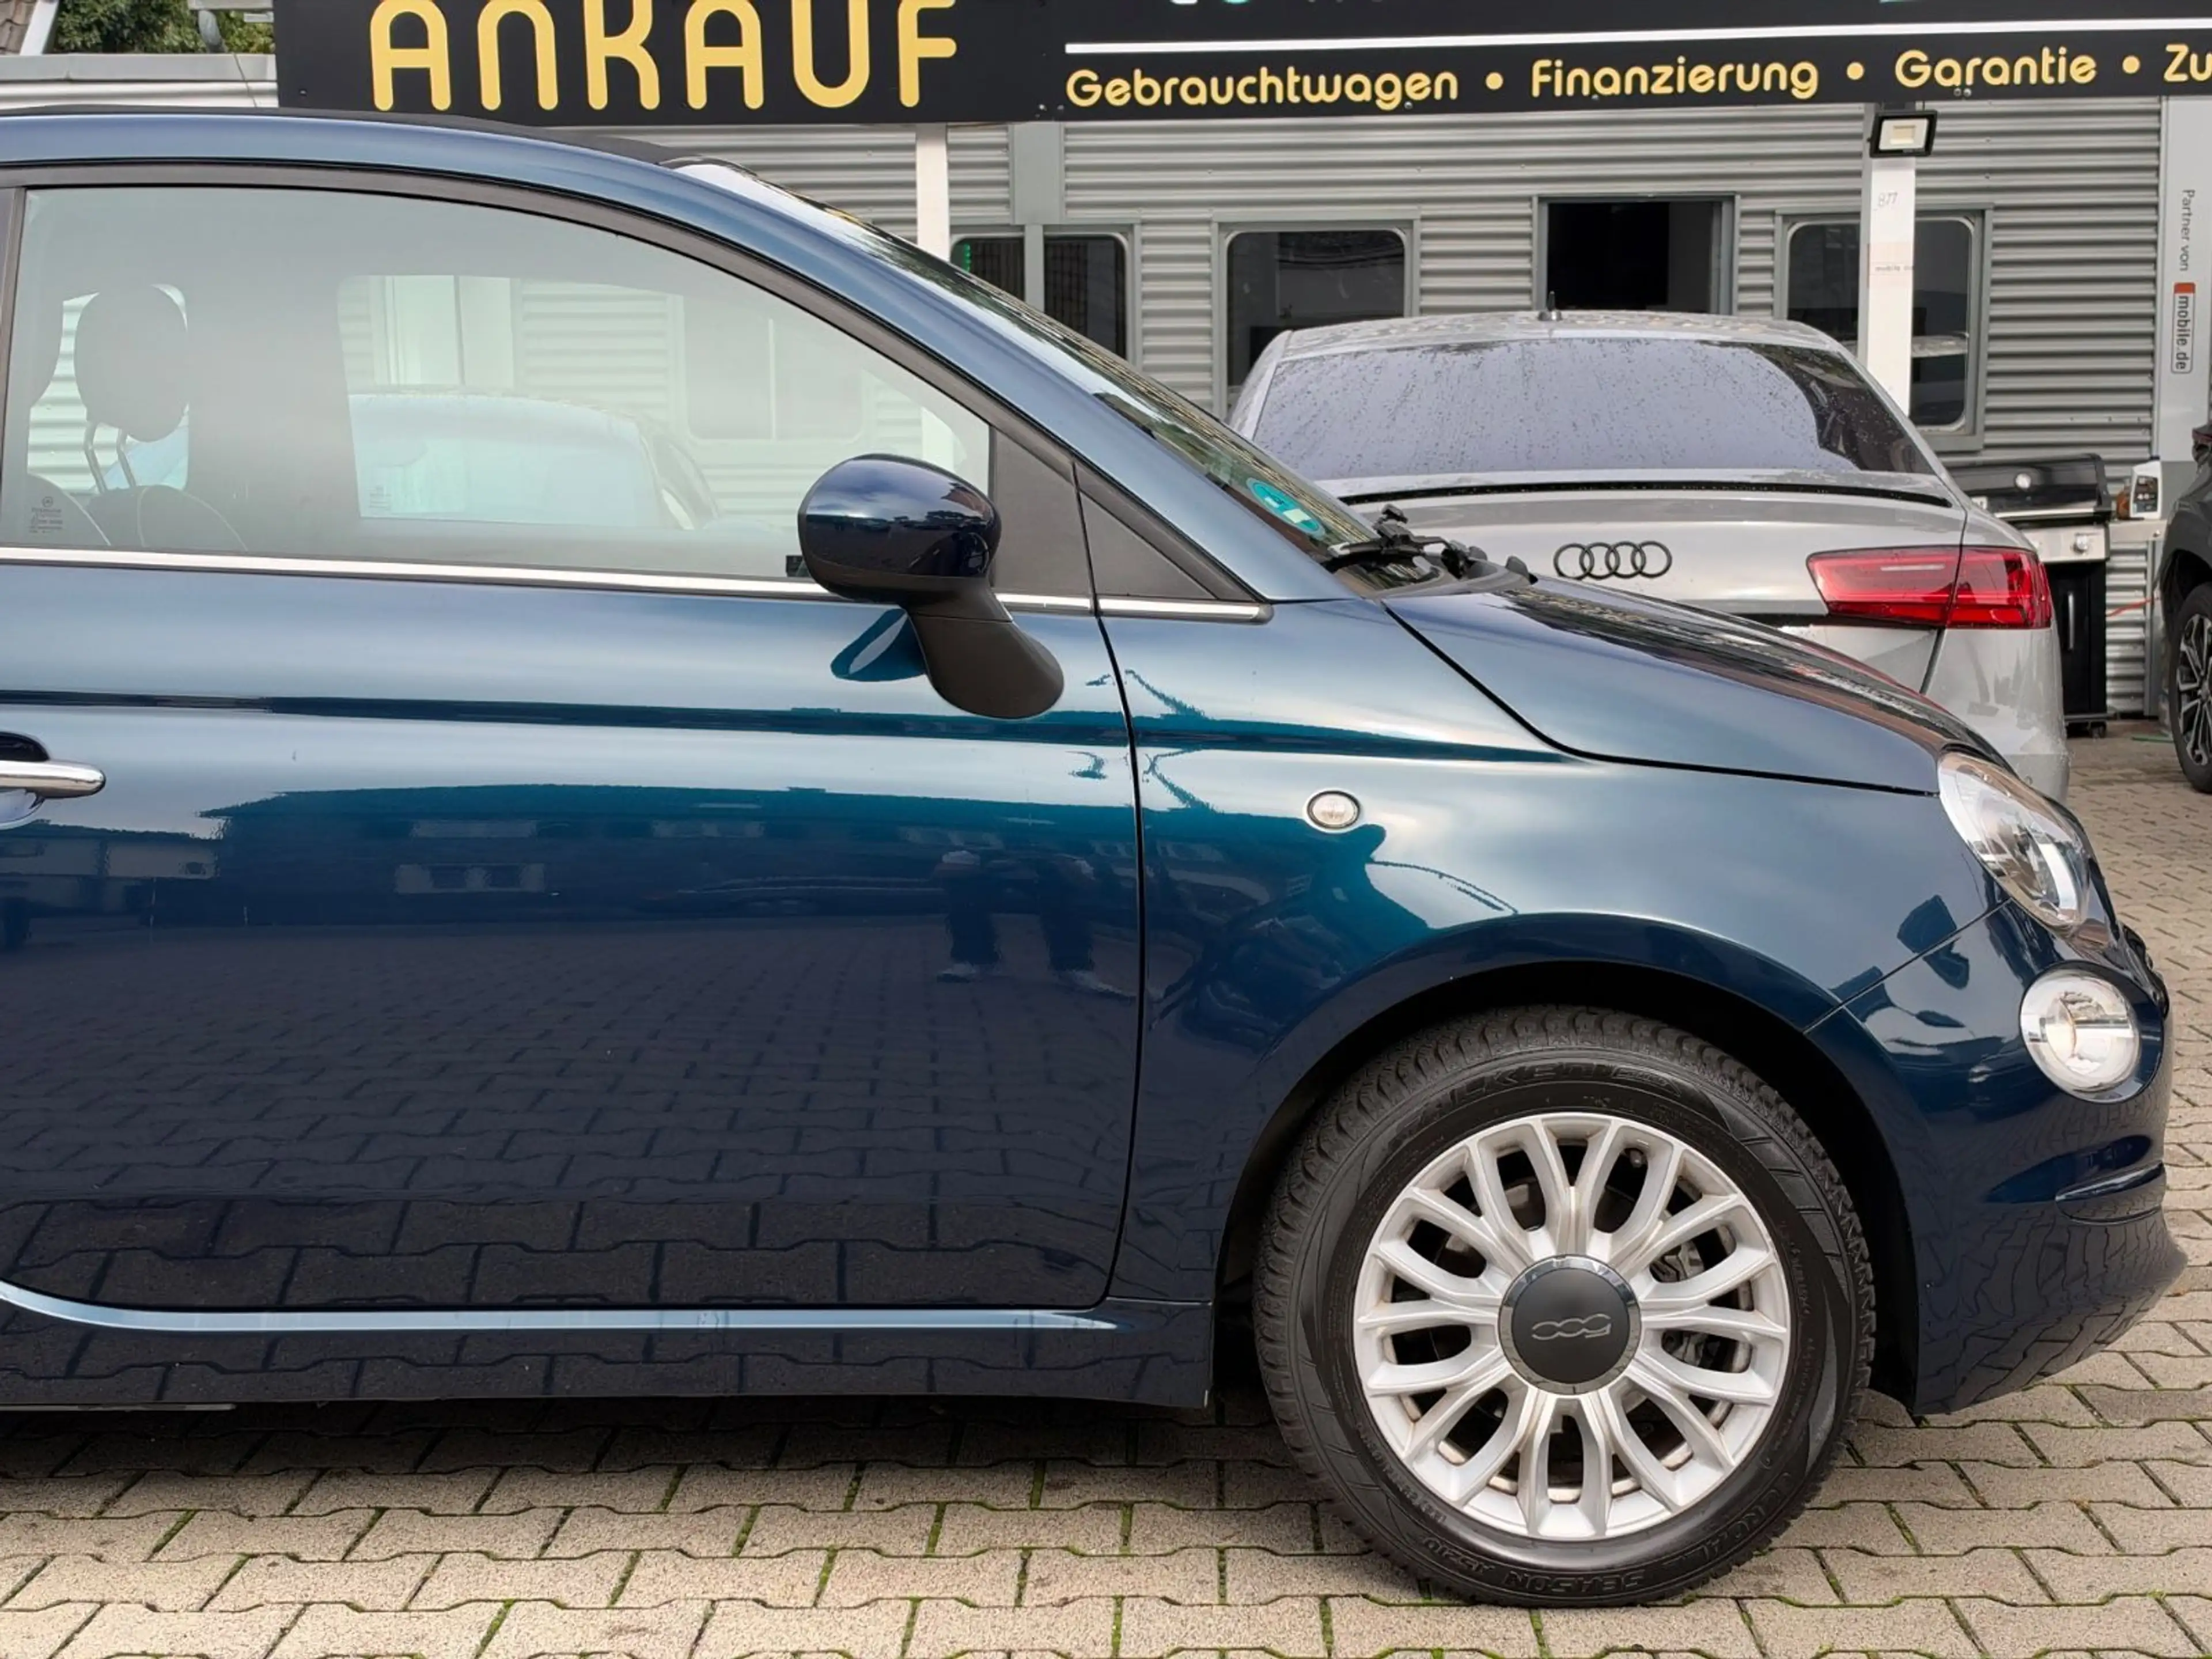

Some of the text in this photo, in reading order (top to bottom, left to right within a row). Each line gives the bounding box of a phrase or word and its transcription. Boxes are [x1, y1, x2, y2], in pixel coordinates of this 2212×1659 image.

[369, 0, 958, 111] ANKAUF
[1066, 67, 1459, 111] Gebrauchtwagen
[1531, 59, 1819, 100] Finanzierung
[1895, 48, 2097, 88] Garantie
[2176, 189, 2195, 370] Partner von mobile.de
[1503, 1567, 1646, 1594] SEASON
